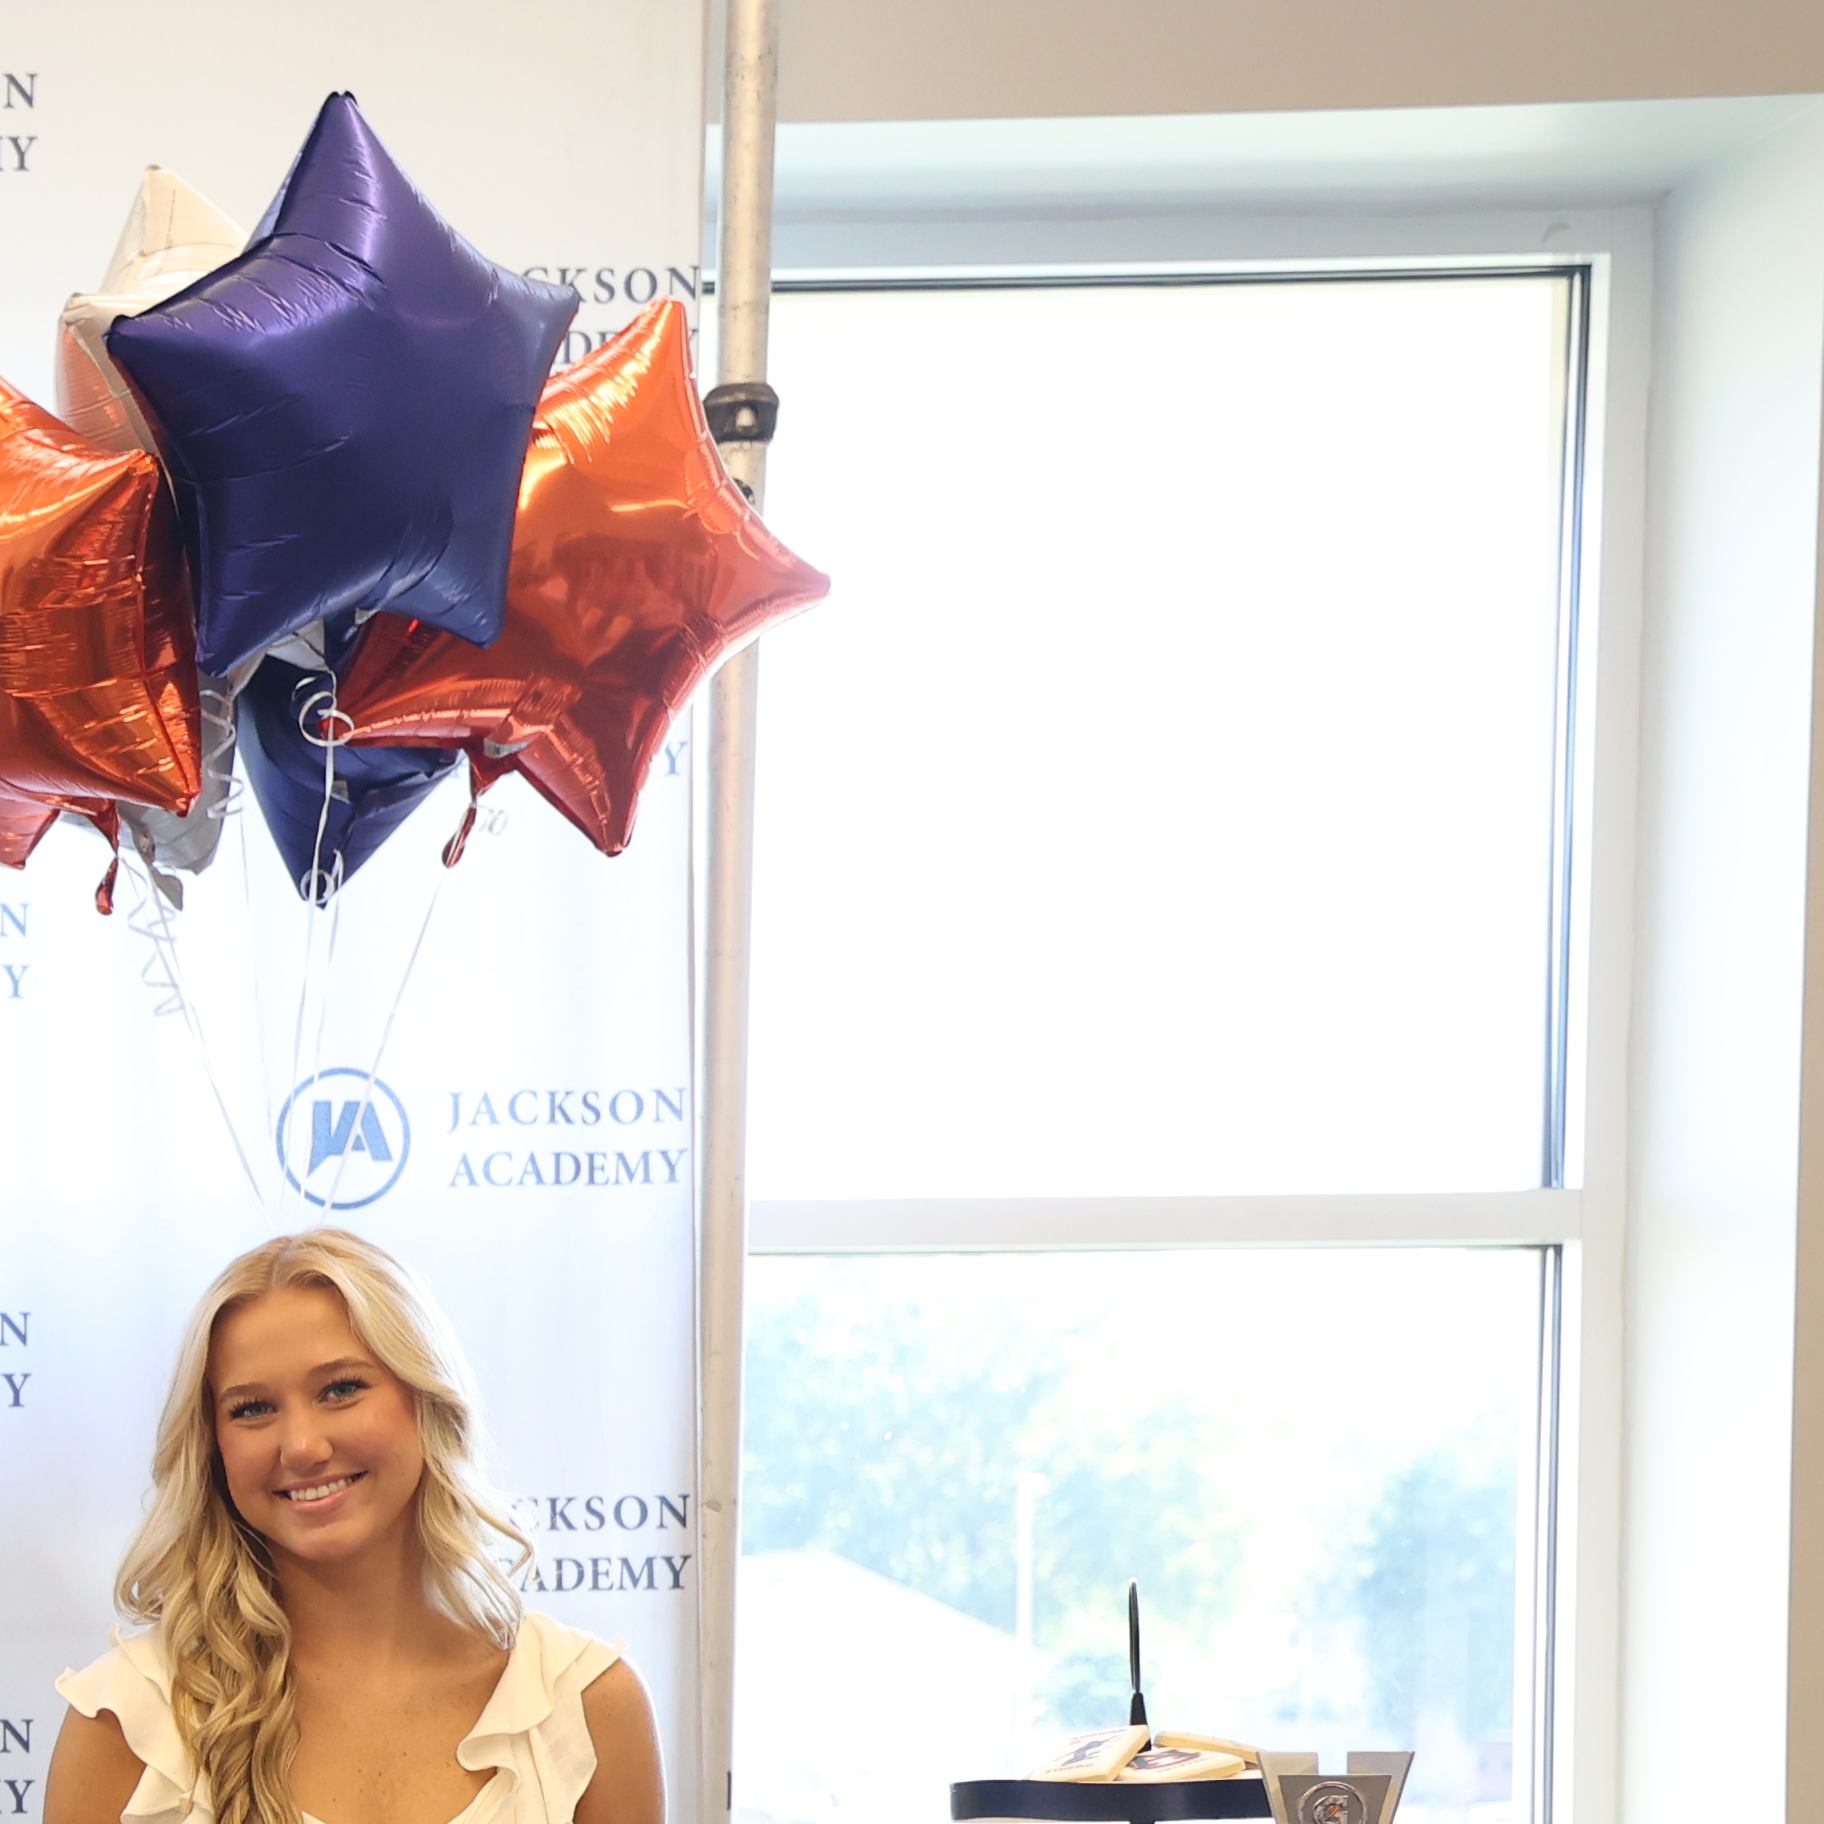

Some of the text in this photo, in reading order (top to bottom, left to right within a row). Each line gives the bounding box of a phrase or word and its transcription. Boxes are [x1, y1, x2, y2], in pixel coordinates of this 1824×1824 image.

[523, 266, 700, 303] KSON
[450, 1087, 687, 1132] JACKSON
[450, 1148, 689, 1188] ACADEMY
[510, 1494, 692, 1532] KSON
[519, 1555, 693, 1593] ADEMY
